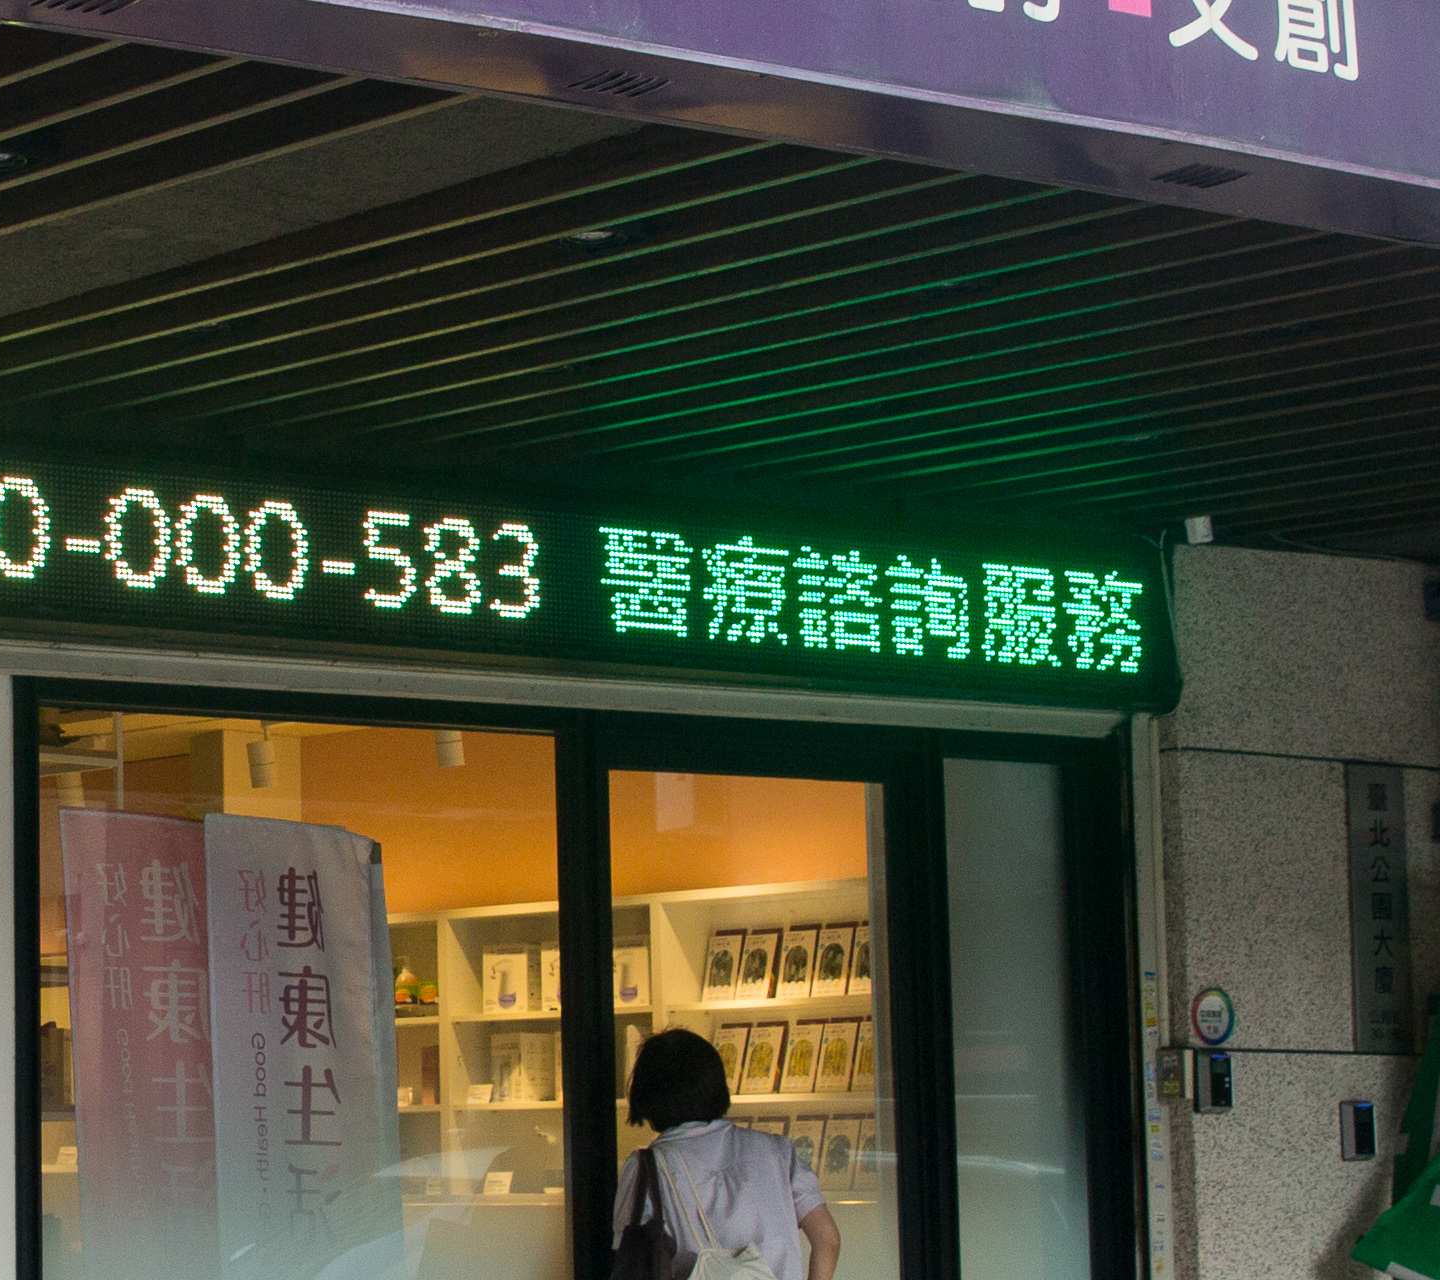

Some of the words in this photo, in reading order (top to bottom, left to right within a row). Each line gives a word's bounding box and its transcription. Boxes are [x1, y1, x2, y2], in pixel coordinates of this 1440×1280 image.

[599, 524, 1145, 675] 醫療諮詢服務
